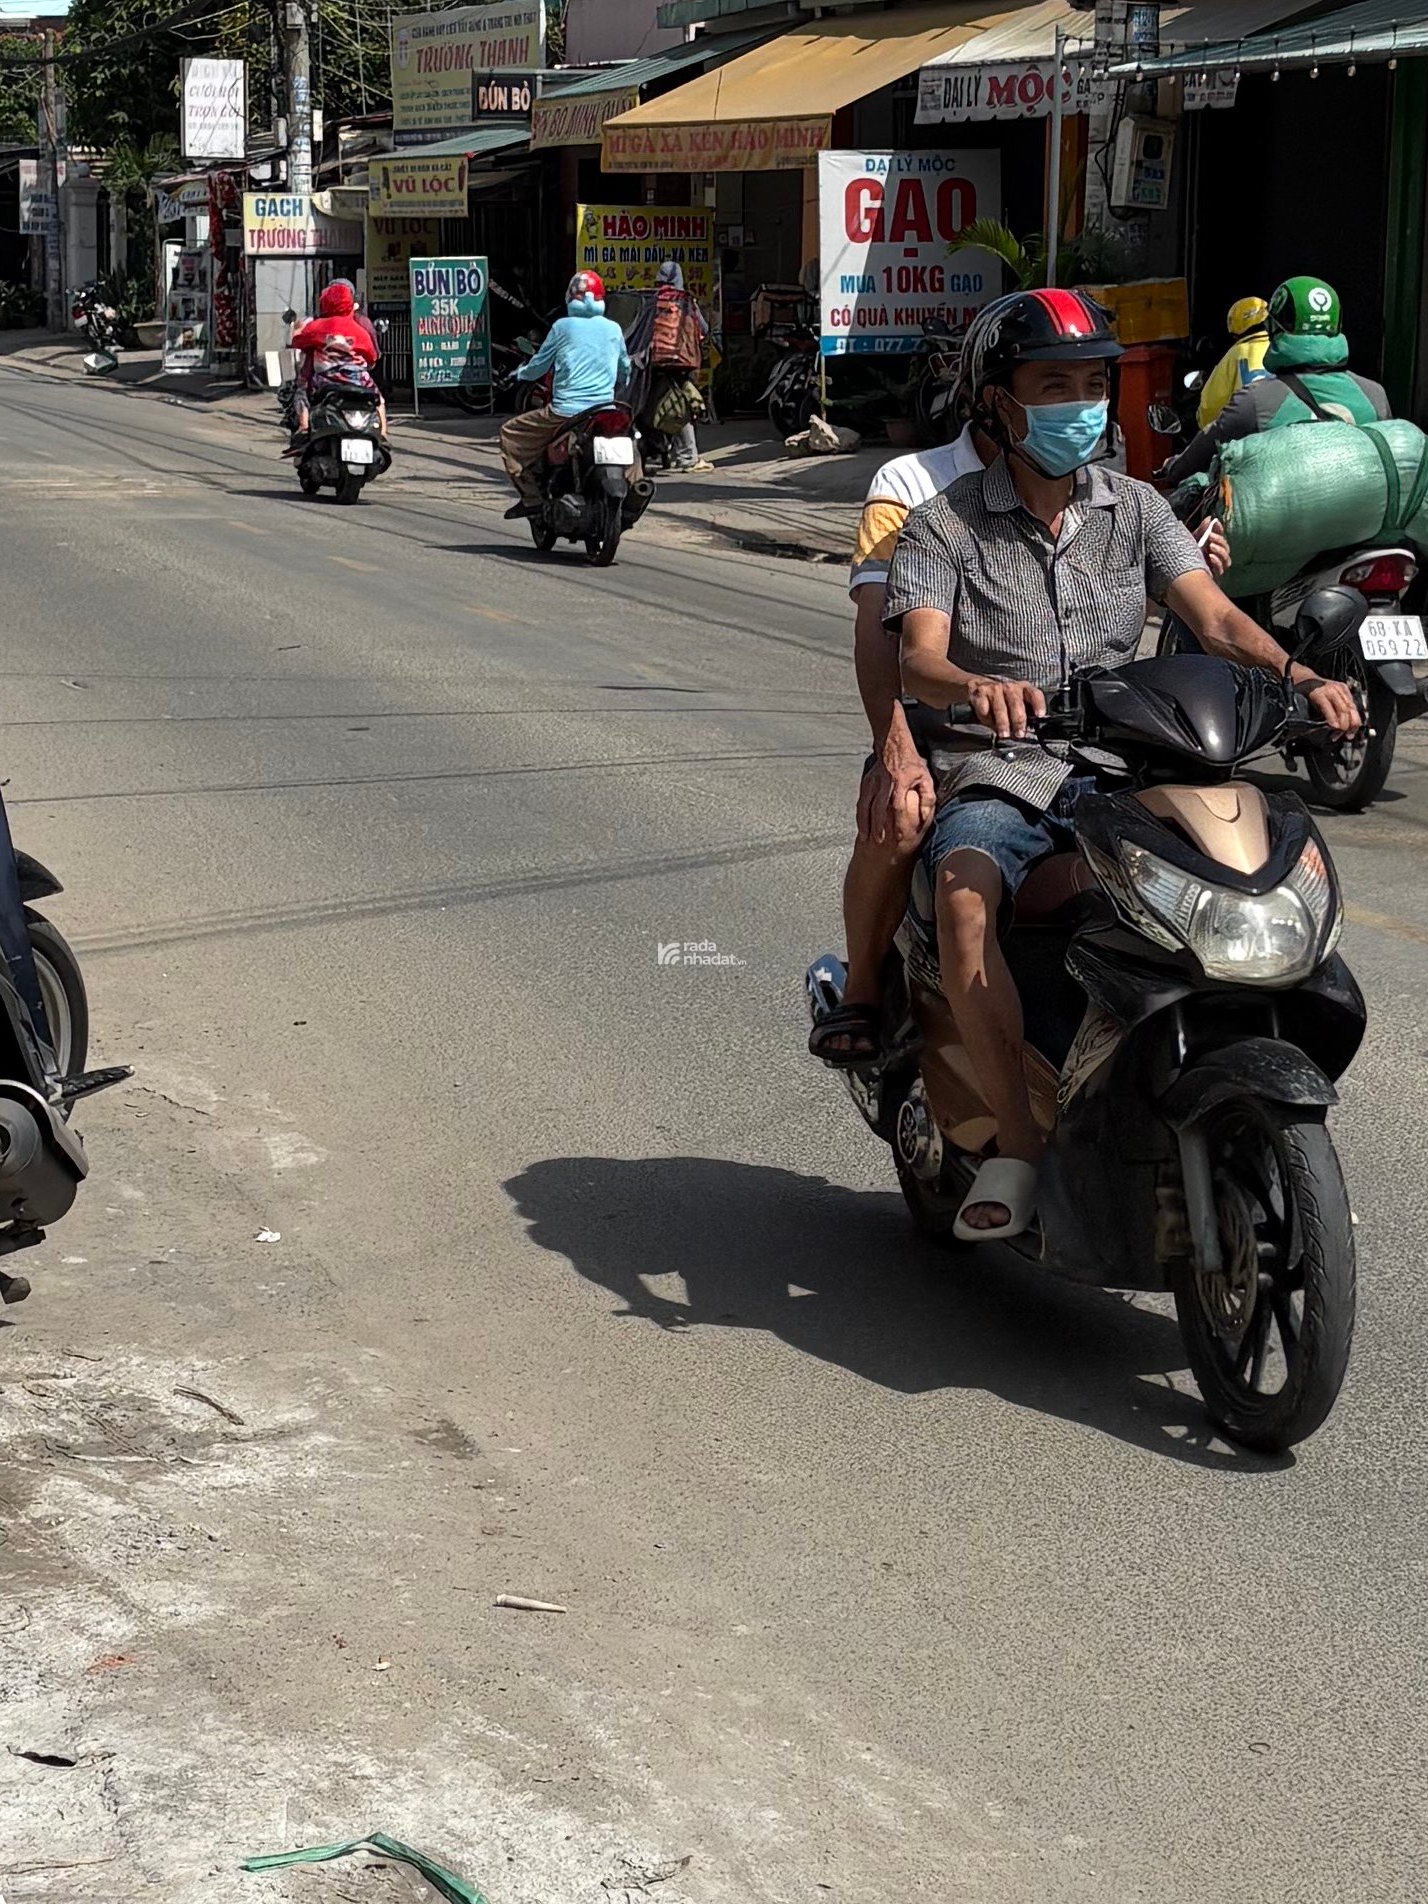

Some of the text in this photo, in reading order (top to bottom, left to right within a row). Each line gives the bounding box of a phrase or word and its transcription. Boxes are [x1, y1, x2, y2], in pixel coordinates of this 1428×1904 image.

[478, 80, 508, 111] BÚN
[511, 80, 531, 111] BÒ
[897, 154, 913, 172] LÝ
[919, 156, 957, 176] MỘC
[255, 197, 303, 222] GẠCH
[844, 177, 977, 258] GẠO
[653, 215, 707, 240] MINH
[414, 261, 452, 297] BÚN
[455, 261, 484, 297] BÒ
[840, 265, 983, 296] MUA 10KG GẠO
[431, 298, 459, 316] 35K
[830, 304, 852, 327] CÓ
